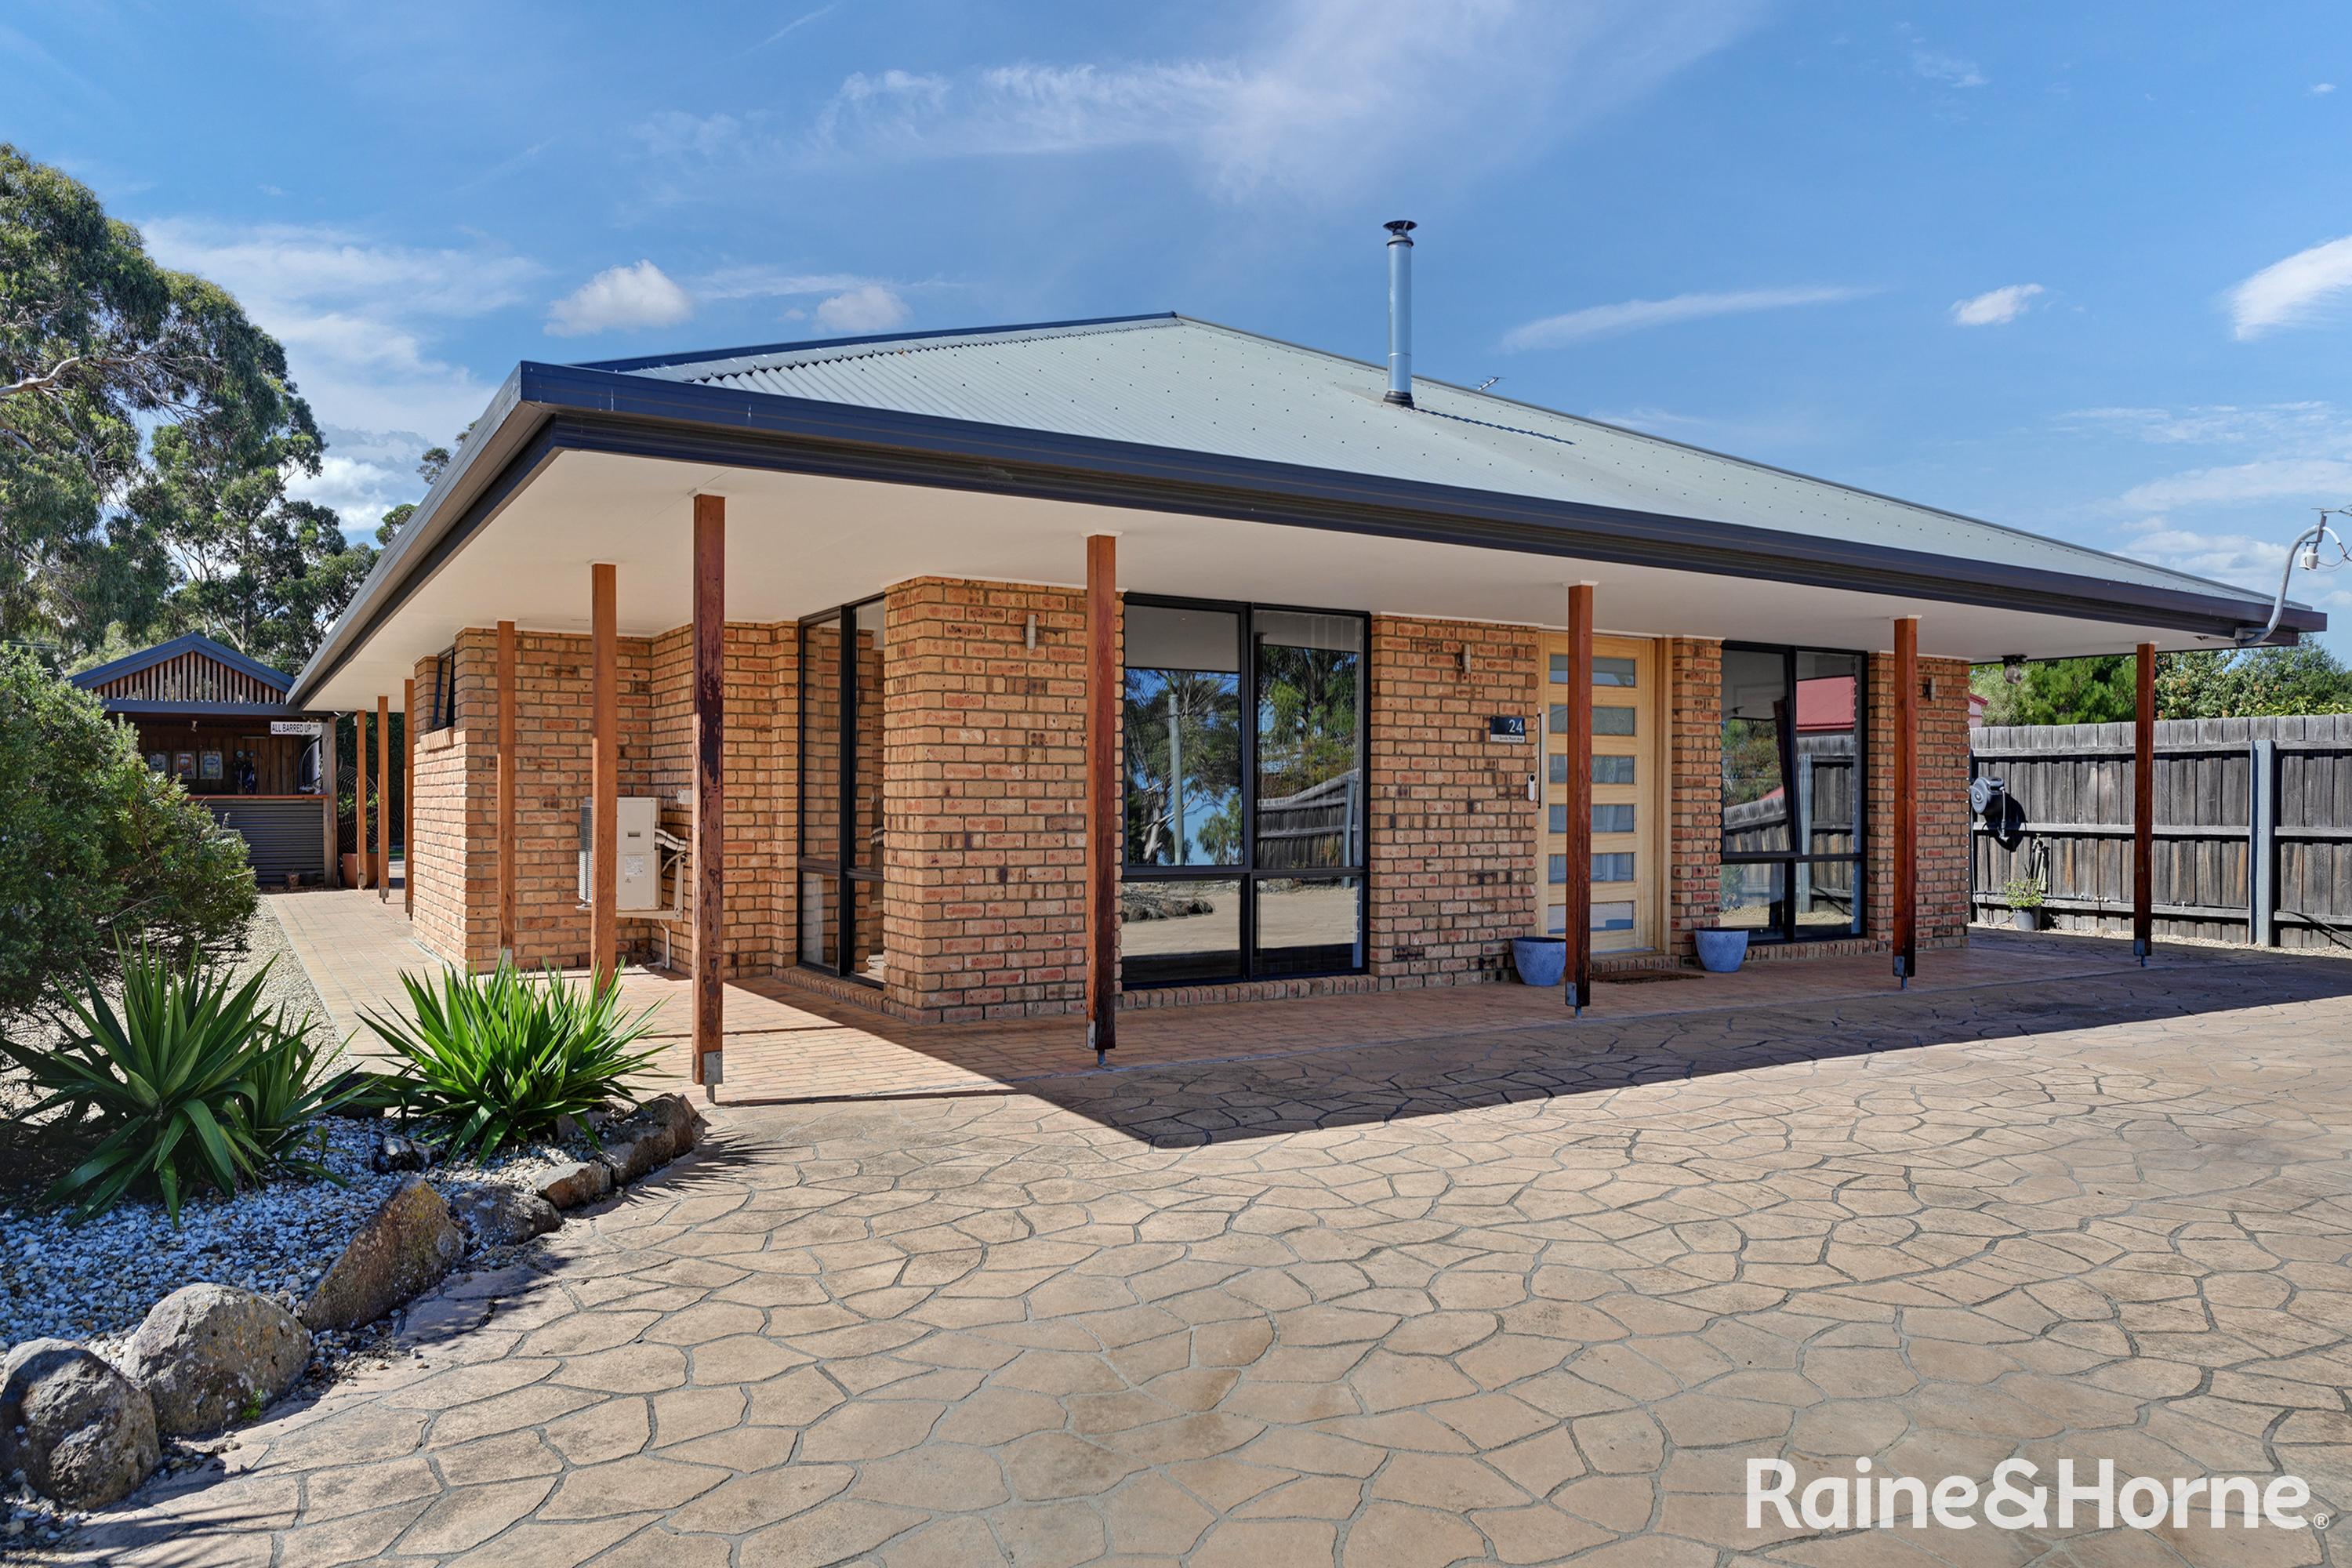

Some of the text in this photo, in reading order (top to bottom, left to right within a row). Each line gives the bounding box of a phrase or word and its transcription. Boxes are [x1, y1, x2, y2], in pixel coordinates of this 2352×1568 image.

[272, 724, 281, 732] ALL
[282, 724, 303, 733] BARRED
[304, 724, 312, 733] UP
[1508, 719, 1523, 733] 24
